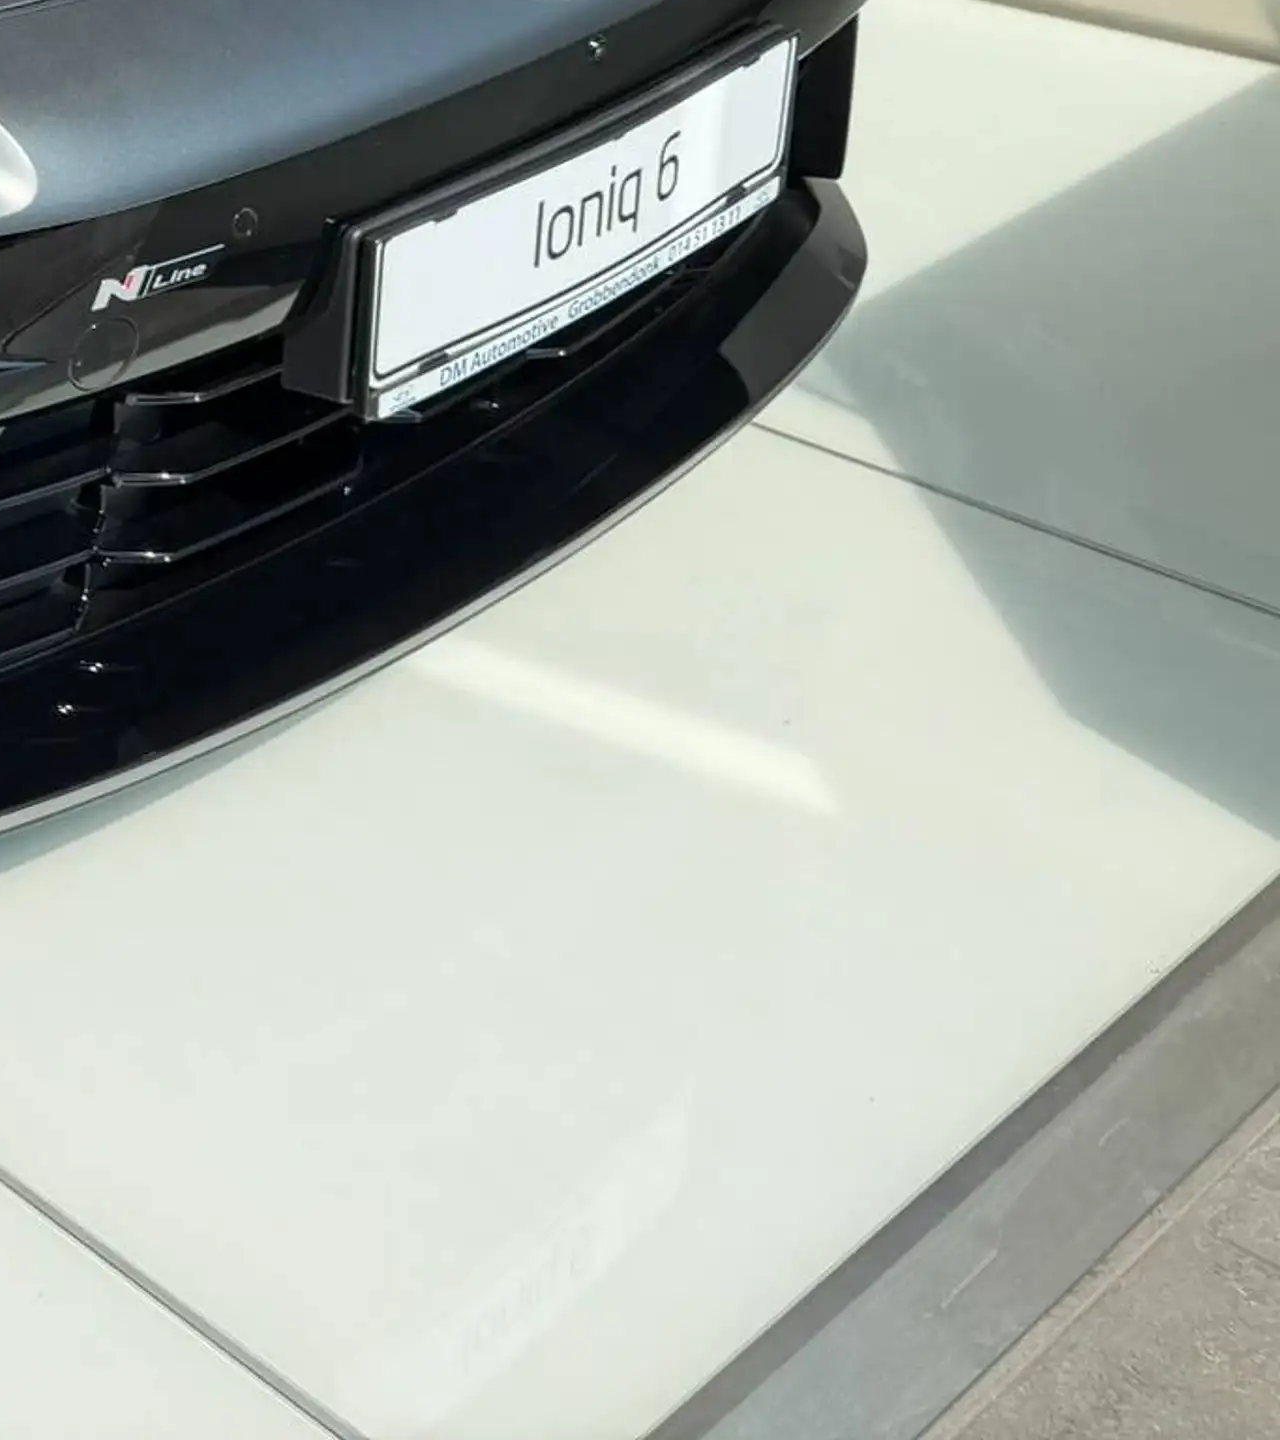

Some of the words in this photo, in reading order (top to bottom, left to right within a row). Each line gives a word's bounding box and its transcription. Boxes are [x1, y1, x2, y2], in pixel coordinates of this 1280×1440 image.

[533, 164, 643, 268] Ioniq
[657, 130, 681, 201] 6
[91, 264, 149, 312] N
[152, 263, 208, 290] Line
[440, 359, 468, 386] DM
[470, 315, 559, 371] Automotive
[568, 253, 659, 319] Grobbendonk
